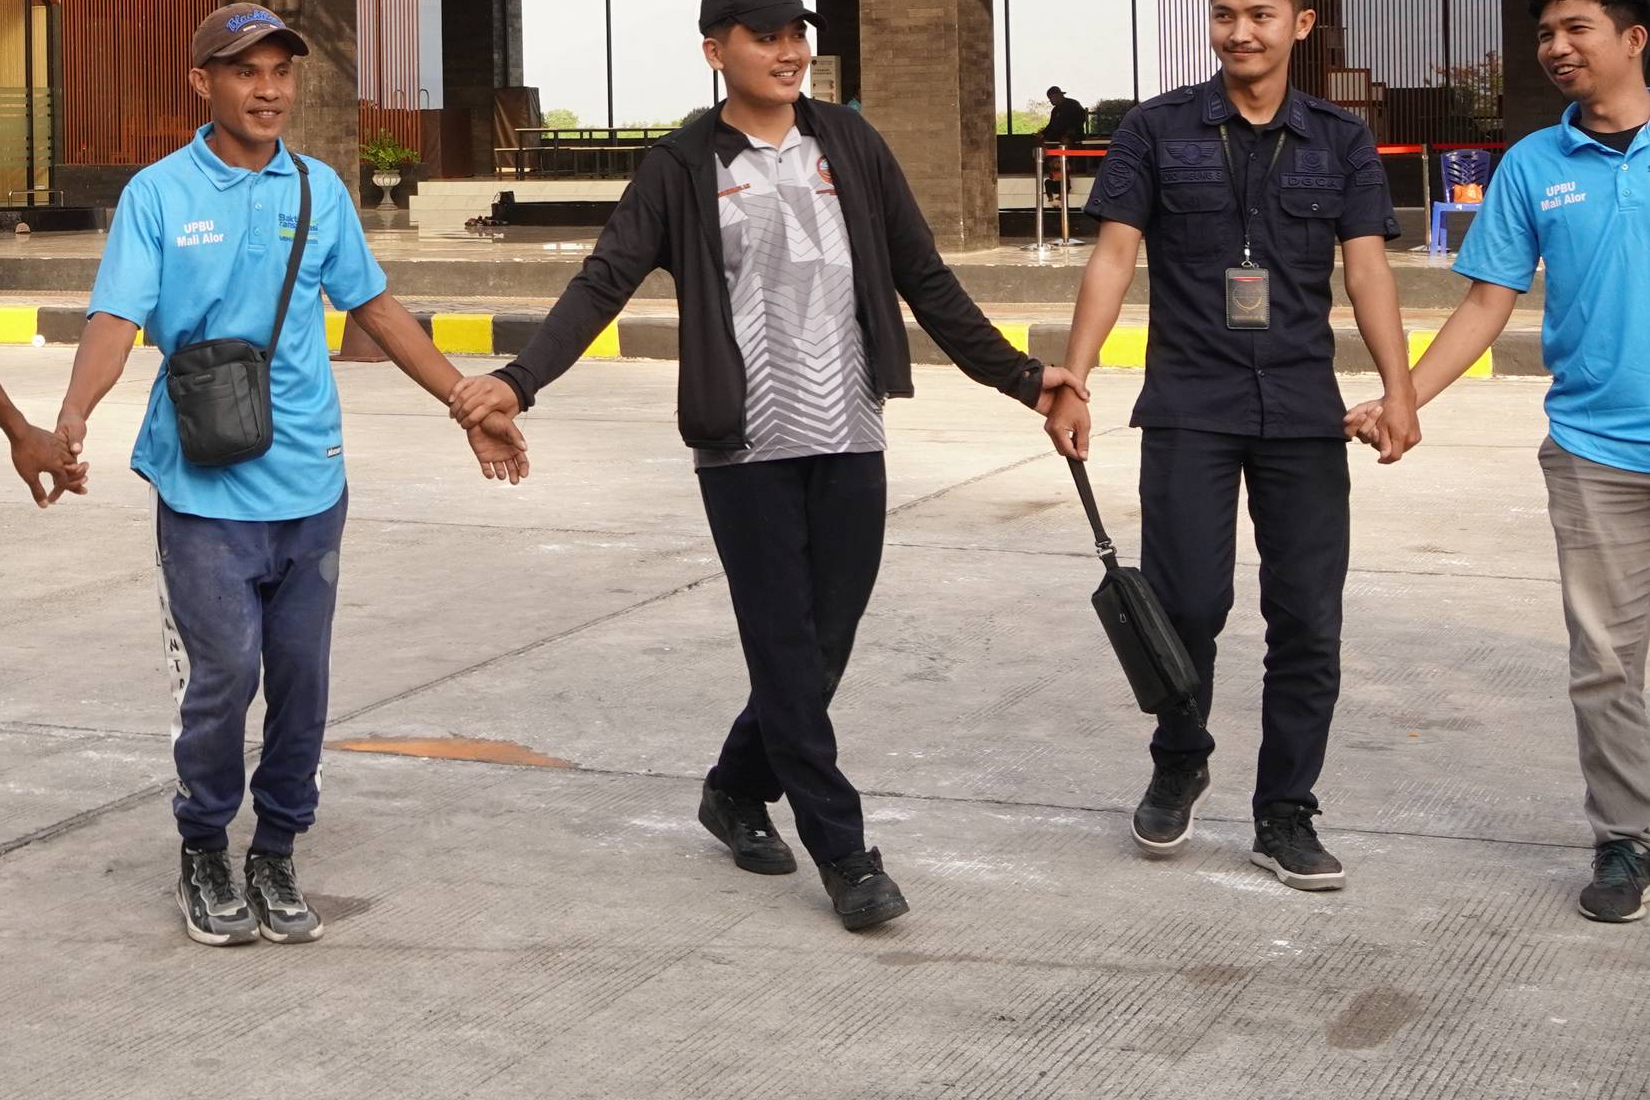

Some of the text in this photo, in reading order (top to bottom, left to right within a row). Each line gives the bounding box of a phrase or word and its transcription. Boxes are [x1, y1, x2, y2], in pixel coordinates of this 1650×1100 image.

[1546, 181, 1576, 197] UPBU
[1540, 192, 1587, 212] Mali Alor
[184, 220, 214, 234] UPBU
[177, 233, 224, 247] Mali Alor
